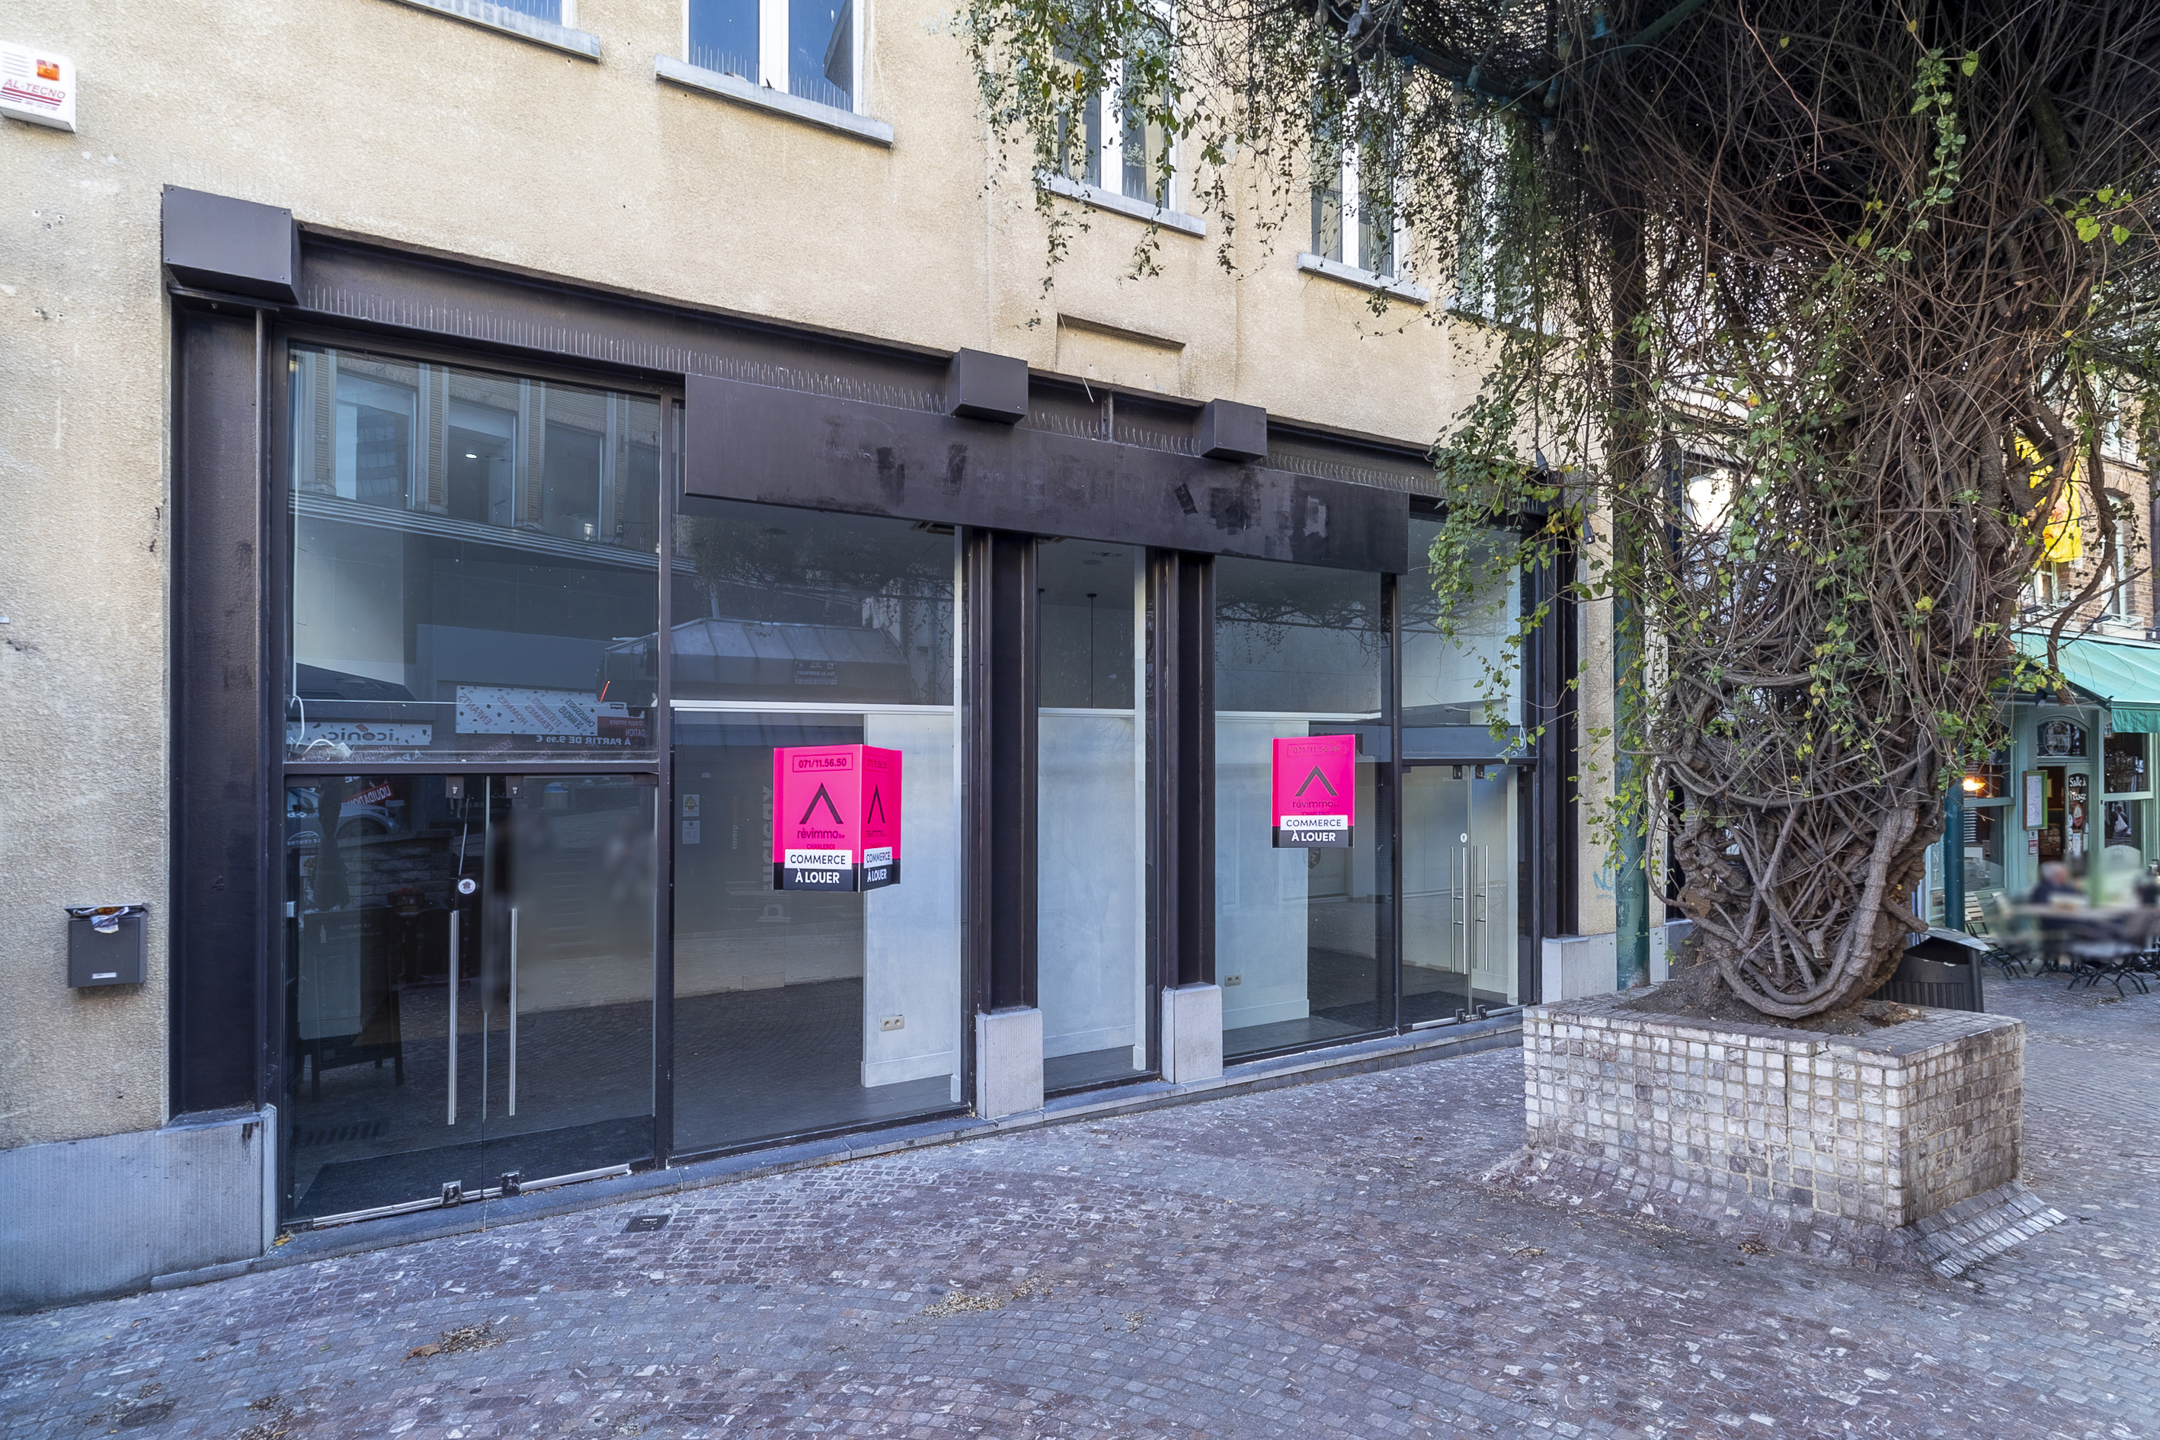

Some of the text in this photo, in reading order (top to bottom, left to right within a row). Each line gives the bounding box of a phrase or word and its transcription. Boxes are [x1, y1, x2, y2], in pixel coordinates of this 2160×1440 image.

[798, 758, 848, 769] 071/11.56.50
[1286, 819, 1342, 827] COMMERCE
[1291, 829, 1336, 842] À LOUER
[790, 854, 846, 865] COMMERCE
[866, 851, 891, 863] COMMERCE
[795, 868, 840, 884] À LOUER
[867, 868, 887, 882] À LOUER
